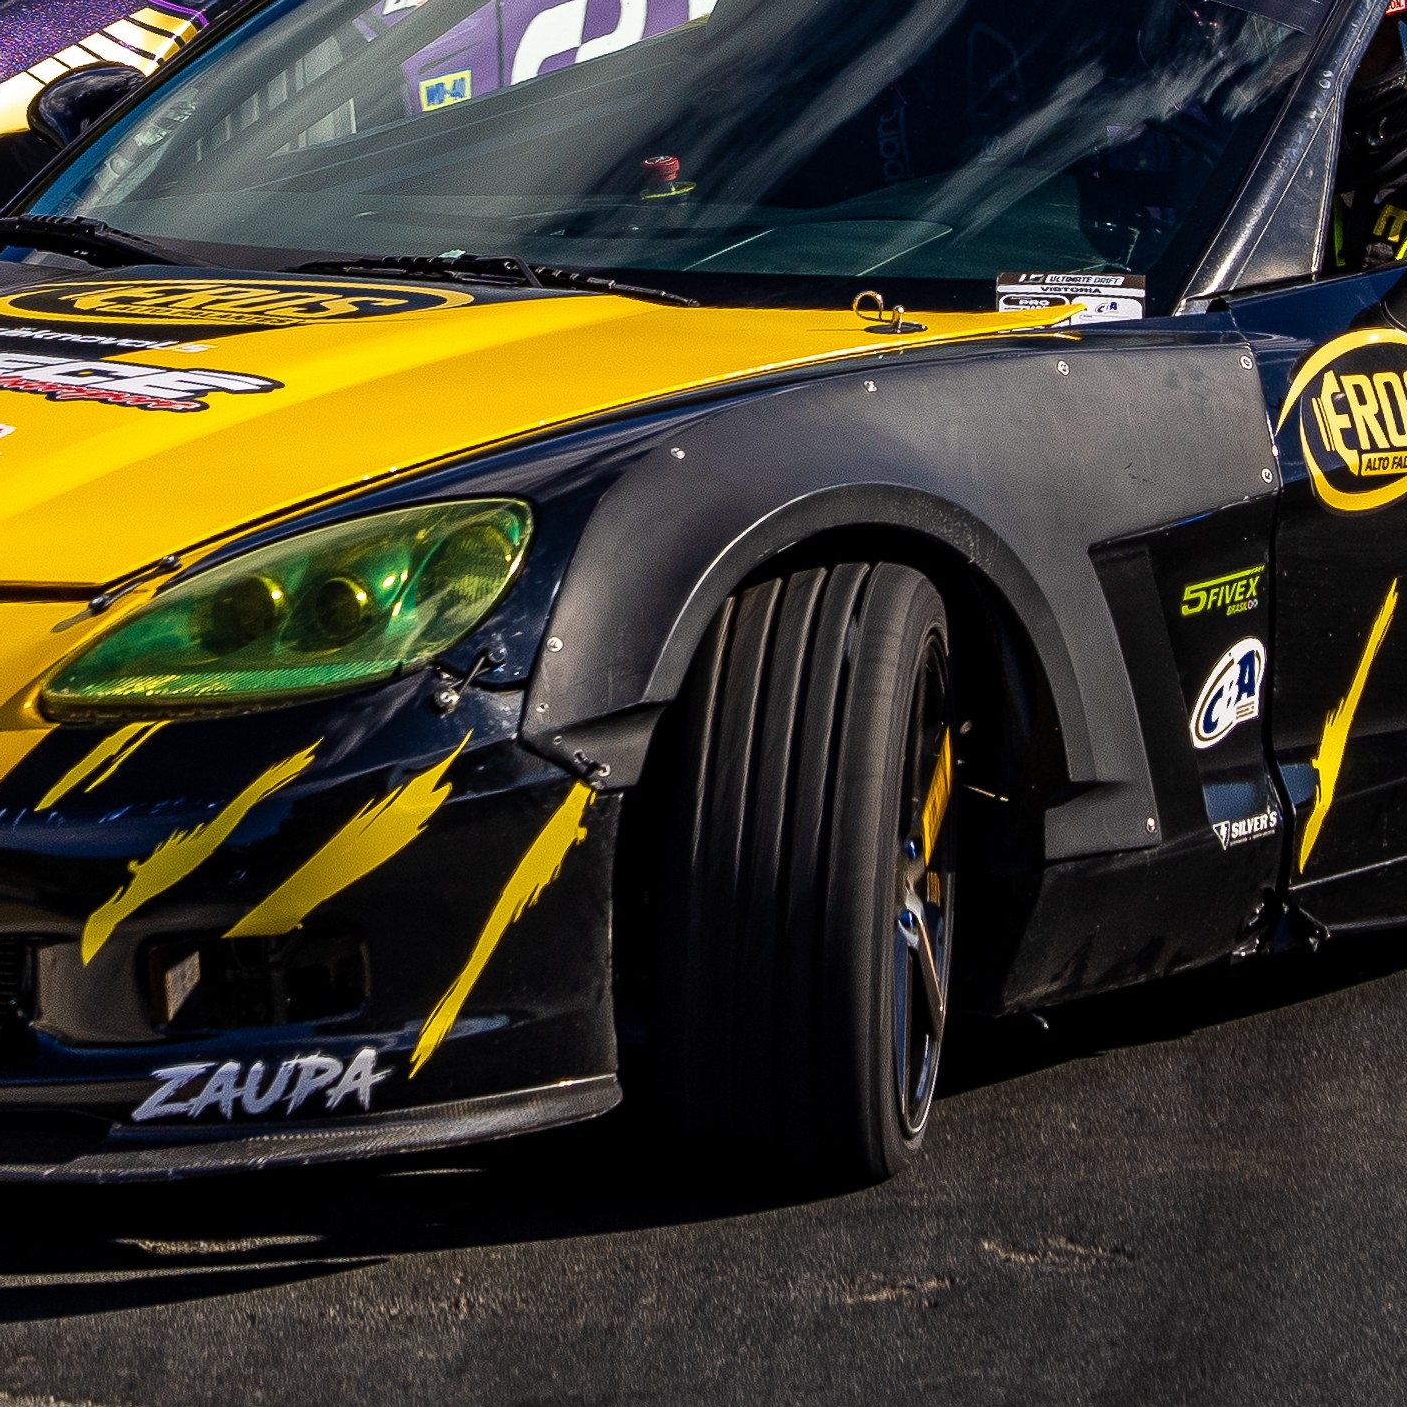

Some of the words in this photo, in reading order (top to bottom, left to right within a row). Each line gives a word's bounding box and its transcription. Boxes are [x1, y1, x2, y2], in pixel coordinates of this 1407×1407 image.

[1364, 456, 1390, 472] ALTO
[1231, 811, 1277, 839] SILVER'S
[131, 1047, 391, 1121] ZAUPA
